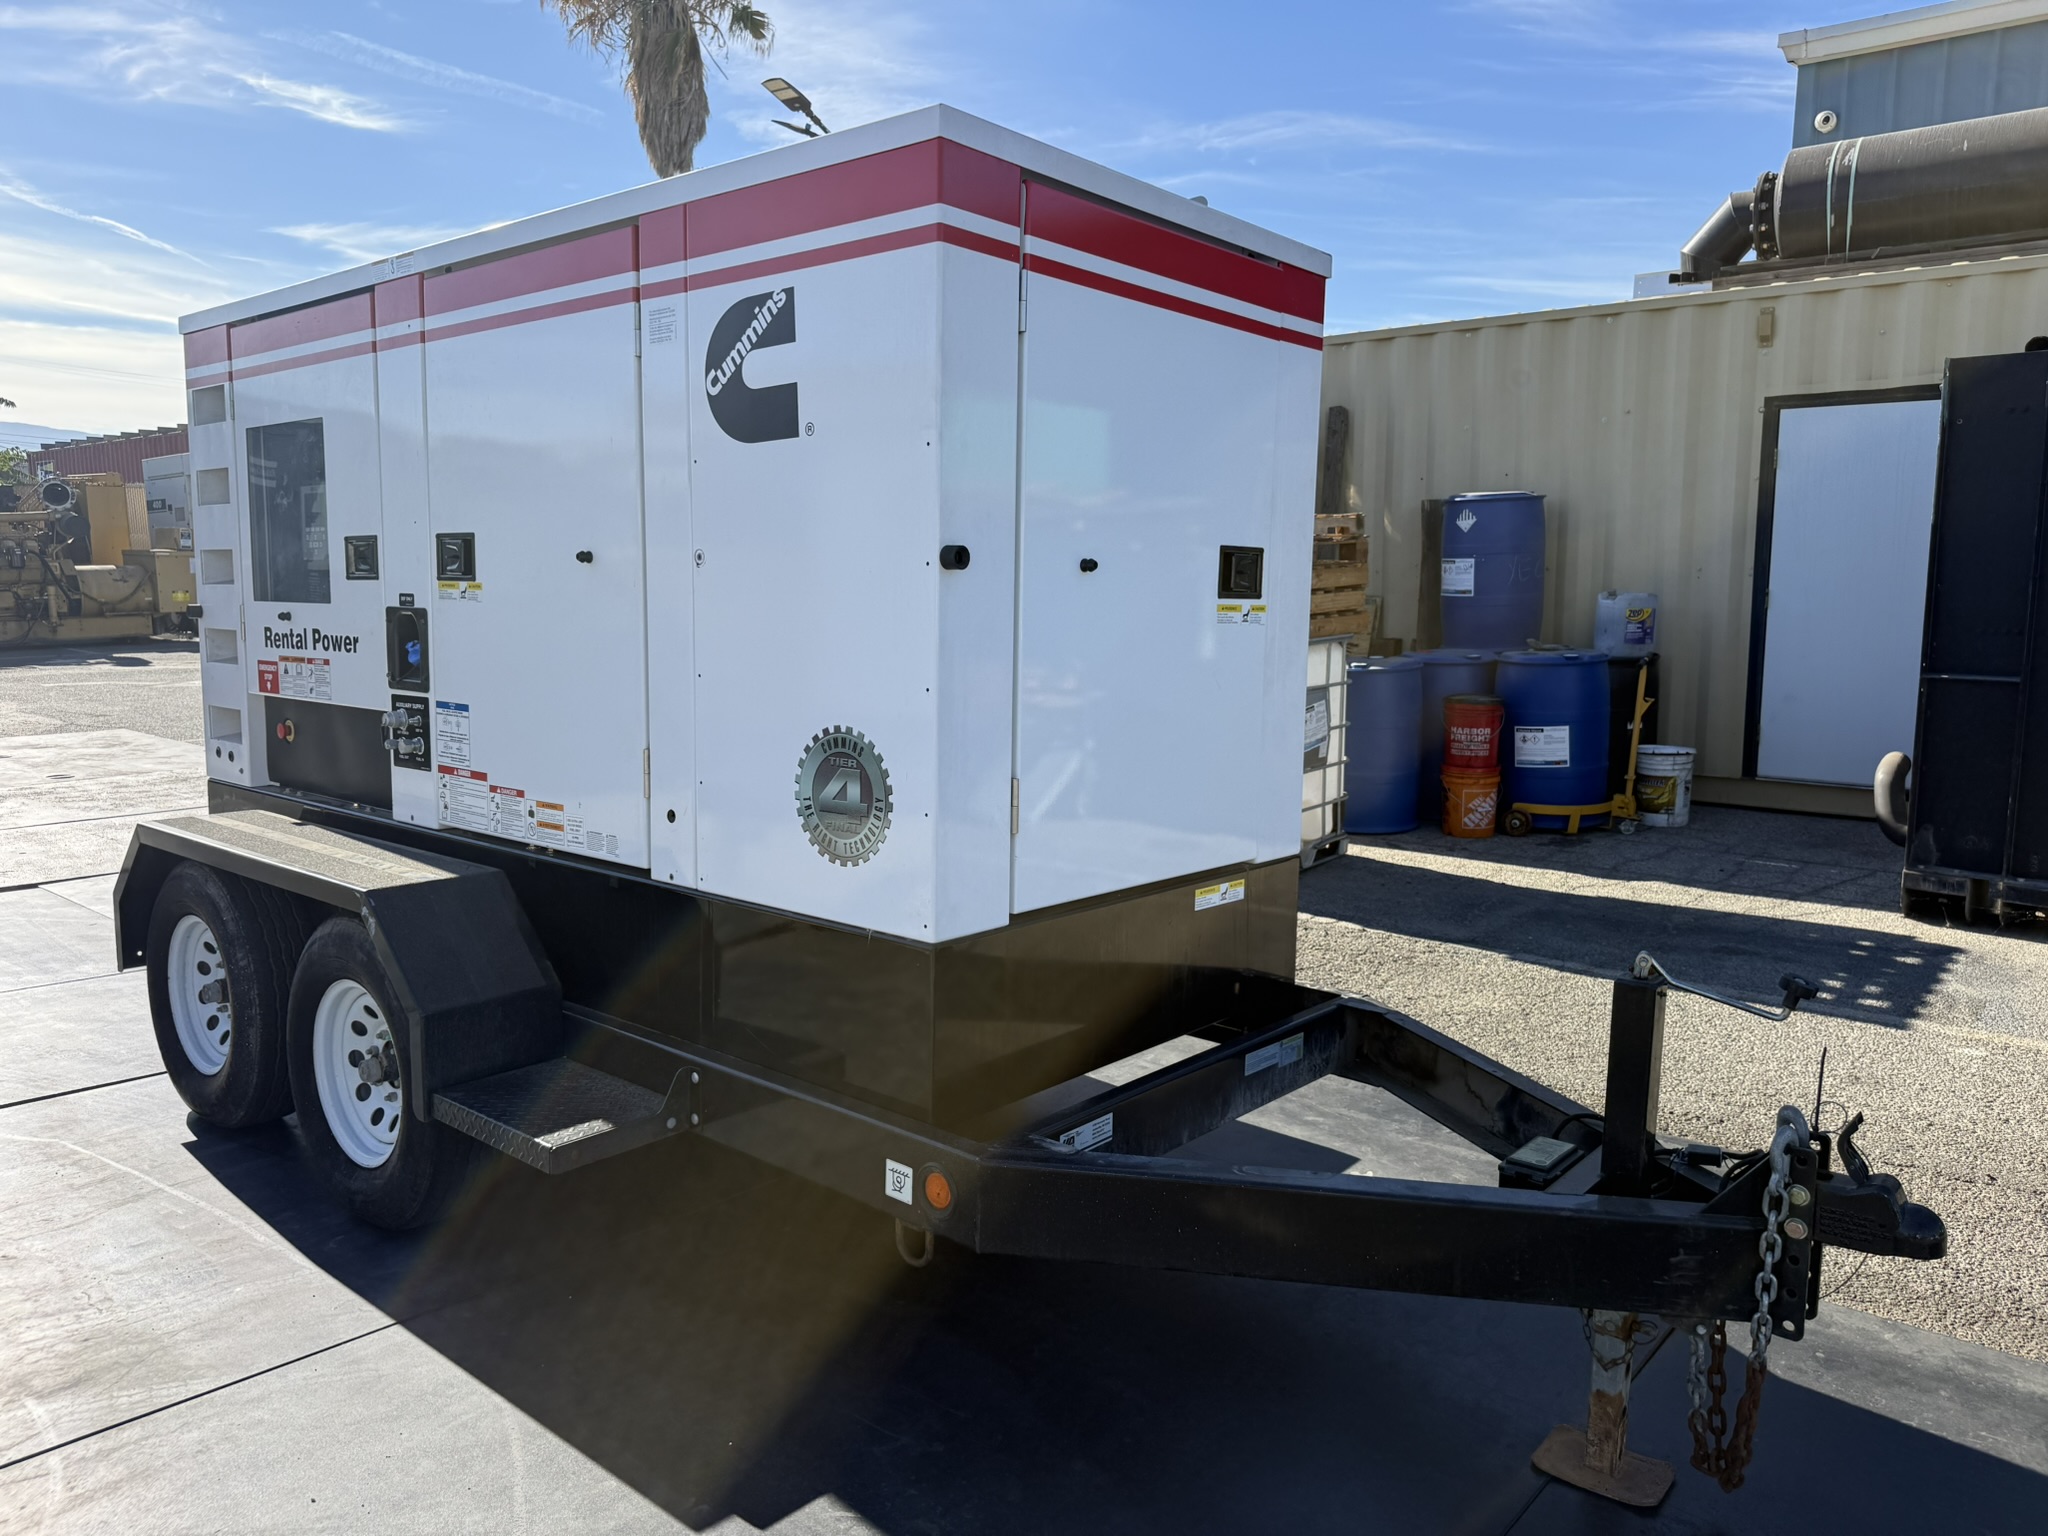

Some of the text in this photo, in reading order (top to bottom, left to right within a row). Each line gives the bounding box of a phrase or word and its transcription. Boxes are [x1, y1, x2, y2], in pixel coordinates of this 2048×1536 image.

[706, 290, 787, 396] Cummins
[264, 626, 359, 653] Rental Power
[1450, 726, 1491, 735] HARBOR
[1450, 734, 1490, 742] FREIGHT
[821, 736, 865, 758] CUMMINS
[827, 756, 858, 768] TIER
[501, 787, 518, 796] DANGER
[819, 767, 868, 819] 4
[803, 796, 885, 855] THE RIGHT TECHNOLOGY
[825, 821, 861, 835] FINAL
